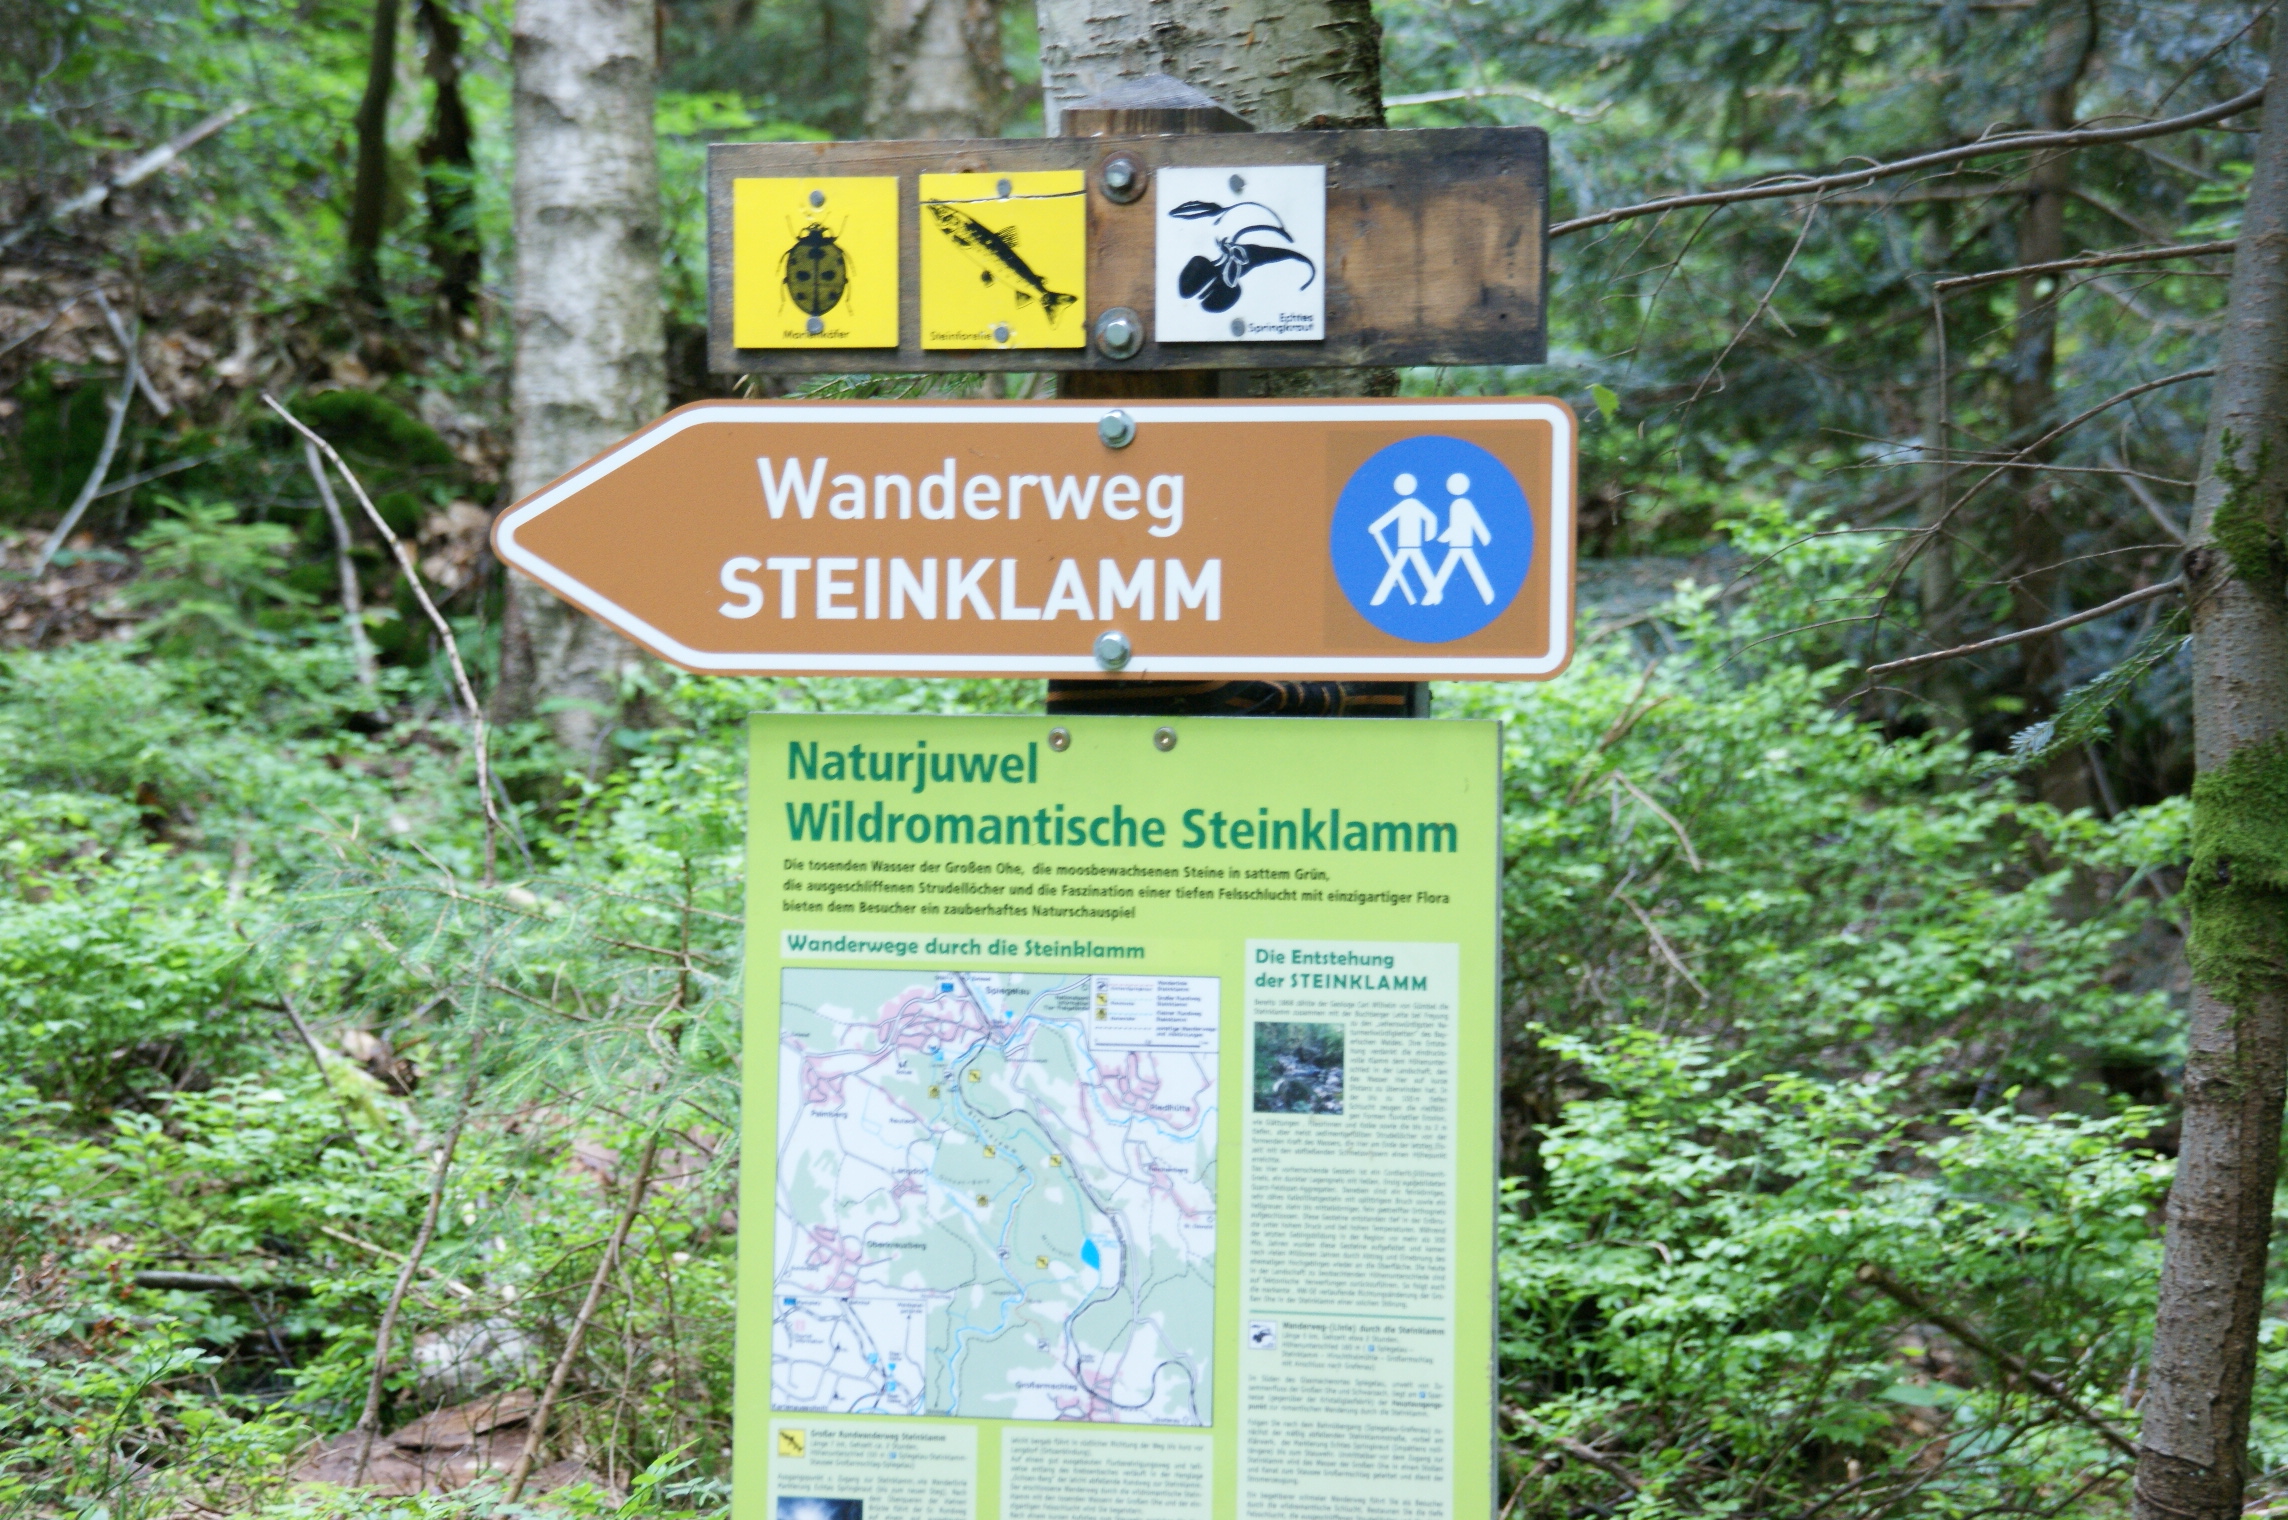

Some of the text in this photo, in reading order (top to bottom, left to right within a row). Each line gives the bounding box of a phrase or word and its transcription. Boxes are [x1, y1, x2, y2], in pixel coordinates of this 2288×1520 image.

[1247, 322, 1314, 334] Springkraut
[1279, 312, 1313, 323] Echtes
[756, 457, 1185, 538] Wanderweg
[718, 556, 1222, 622] STEINKLAMM
[788, 740, 1038, 794] Naturjuwel
[785, 800, 1459, 853] Wildromantische Steinklamm
[783, 858, 1330, 883] Die tosenden Wasser der Großen Ohe, die moosbewachsenen Steine in sattem Grün,
[783, 879, 1451, 906] die ausgeschliffenen Strudellöcher und die Faszination einer tiefen Felsschlucht mit einzigartiger Flora
[782, 899, 1136, 921] bieten dem Besucher ein zauberhaftes Naturschauspiel
[787, 934, 1146, 959] Wanderwege durch die Steinklamm
[1255, 948, 1395, 969] Die Entstehung
[1255, 973, 1428, 992] der STEINKLAMM
